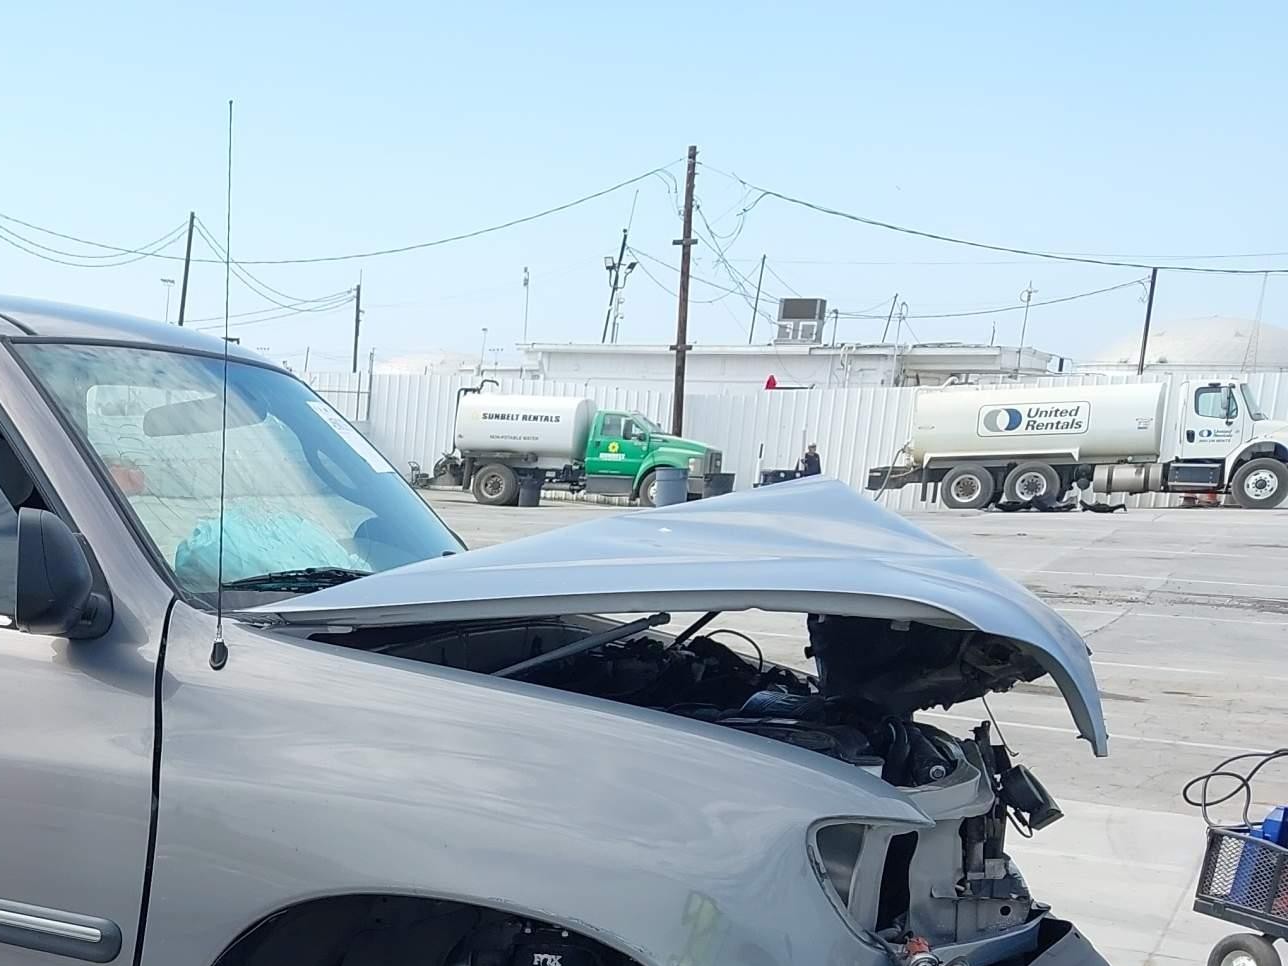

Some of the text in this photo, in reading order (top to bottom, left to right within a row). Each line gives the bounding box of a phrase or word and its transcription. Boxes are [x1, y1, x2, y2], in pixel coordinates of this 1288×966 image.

[481, 412, 561, 423] SUNBELT RENTALS
[1027, 405, 1080, 419] United
[1024, 418, 1083, 431] Rentals
